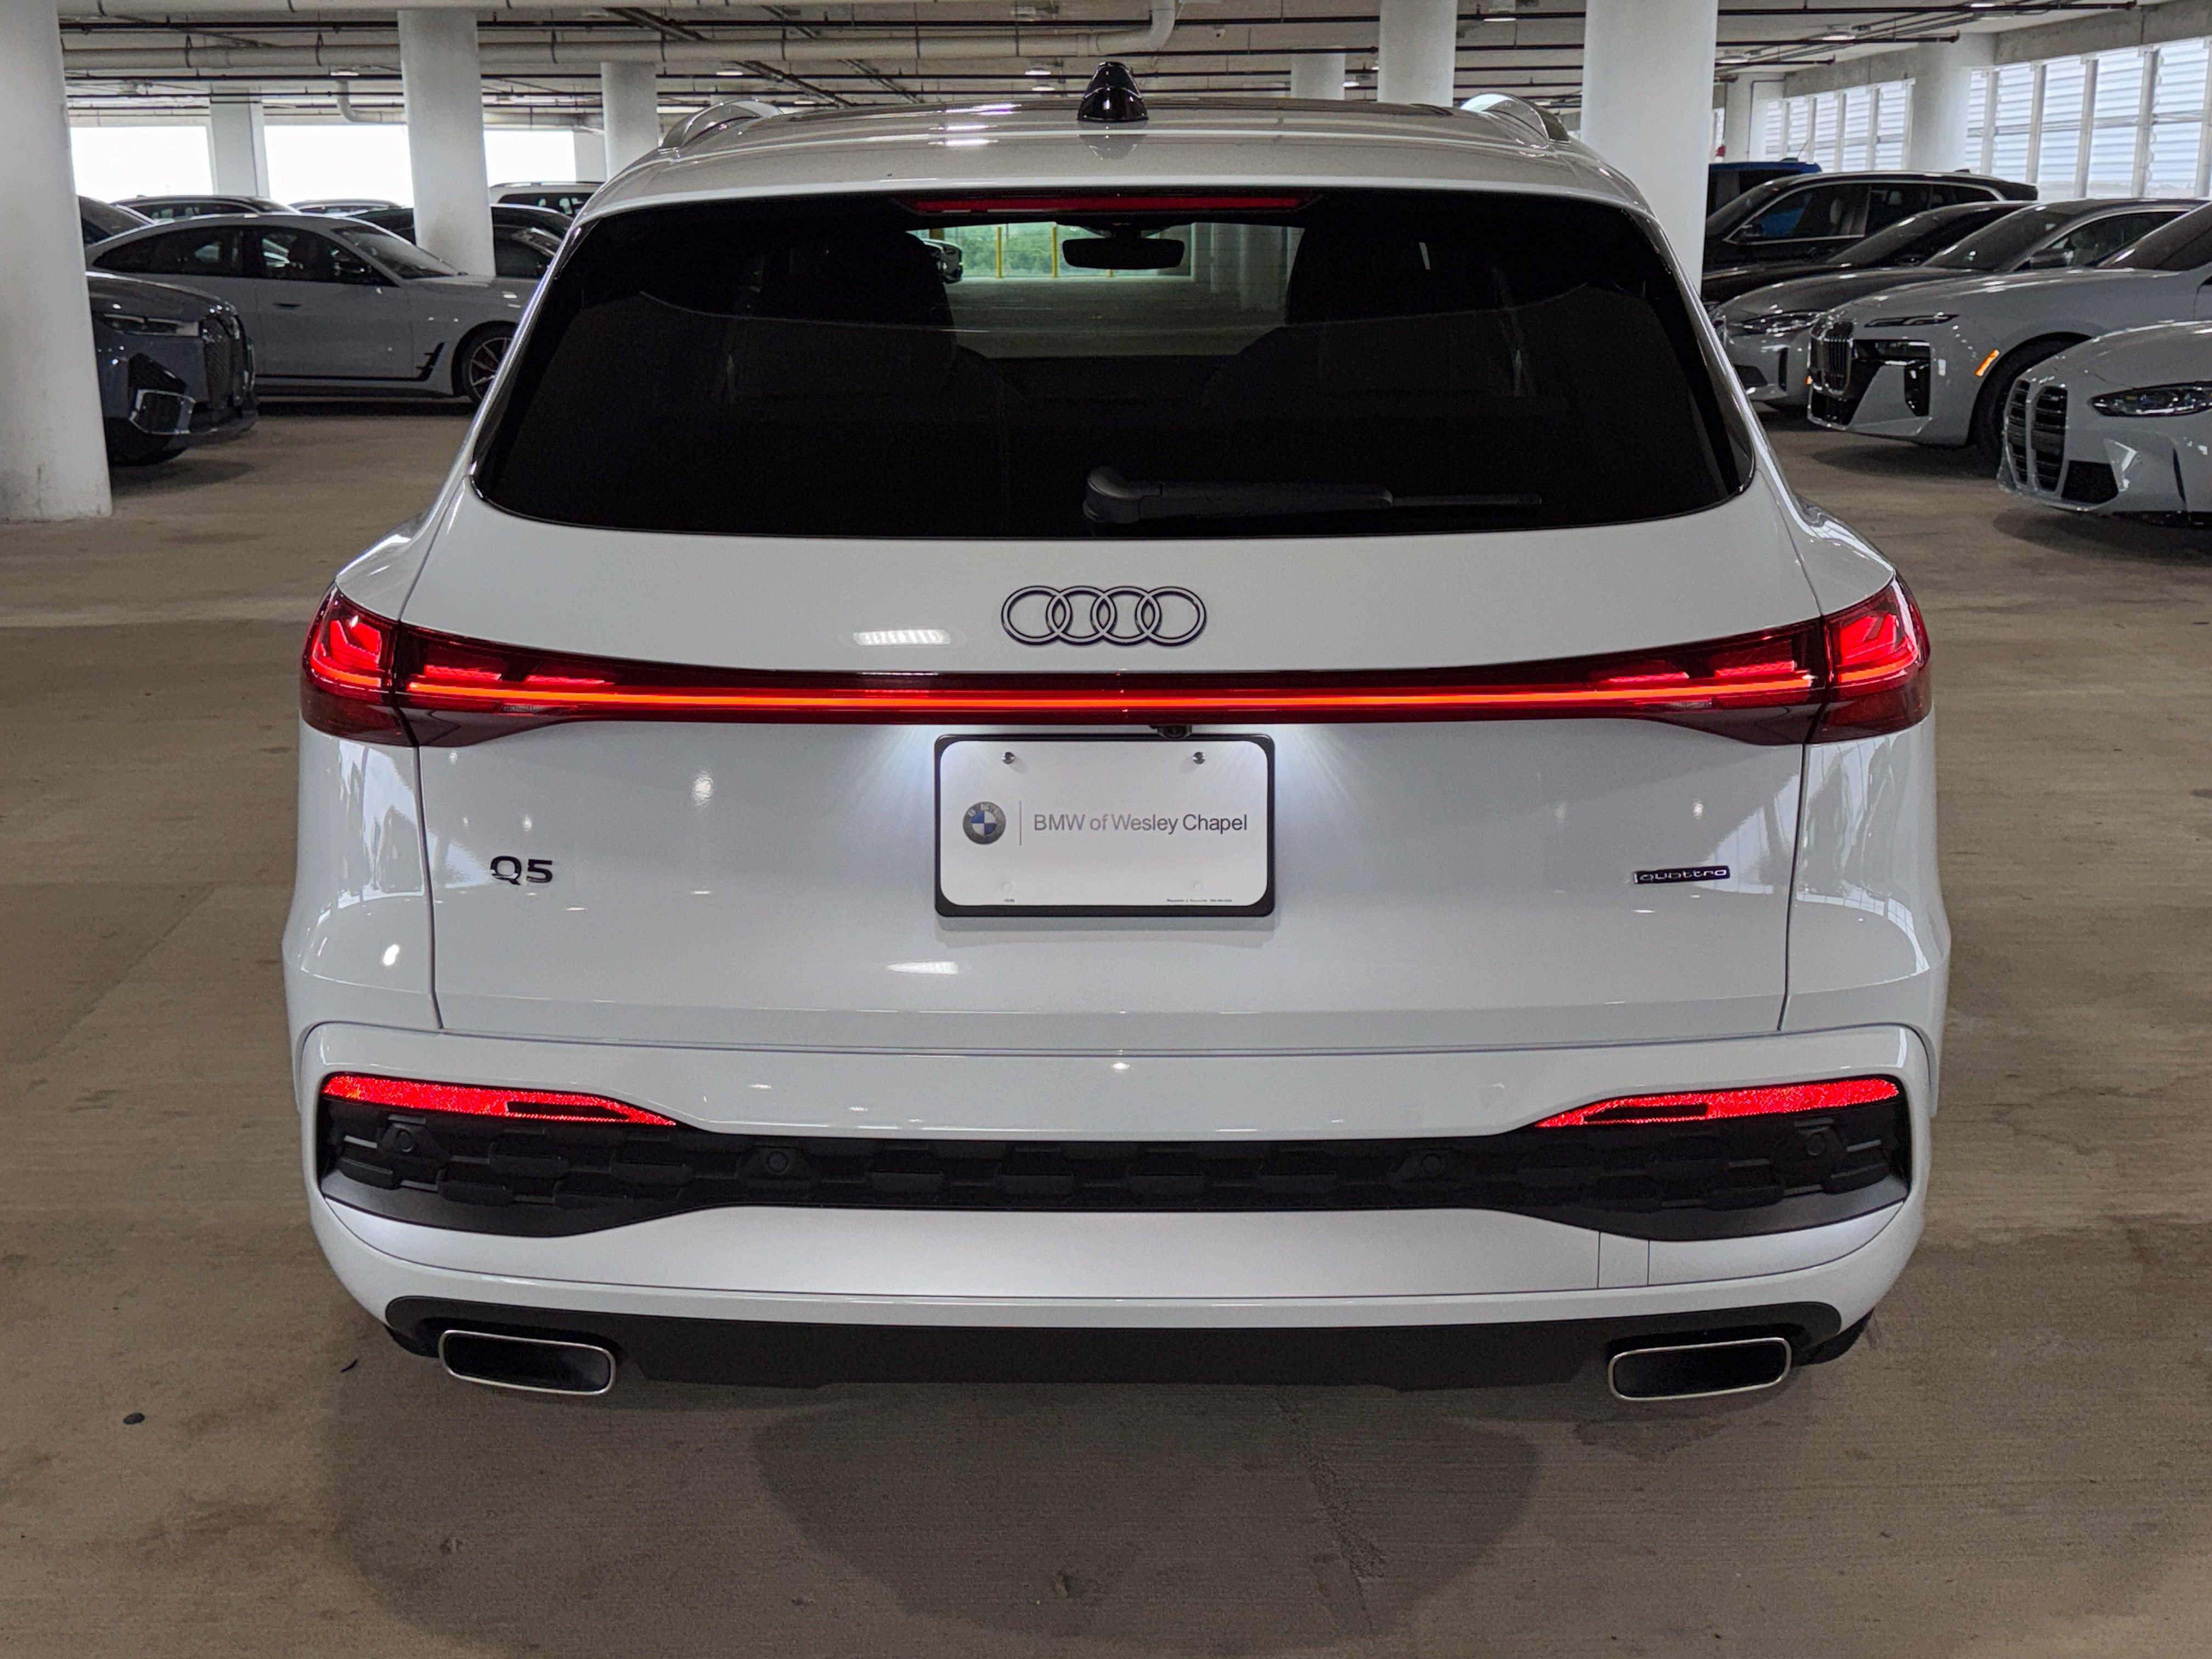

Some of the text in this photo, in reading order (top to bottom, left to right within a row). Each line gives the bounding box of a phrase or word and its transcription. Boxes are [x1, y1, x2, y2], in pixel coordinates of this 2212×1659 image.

[1034, 814, 1247, 835] BMW of Wesley Chapel
[490, 855, 552, 885] Q5
